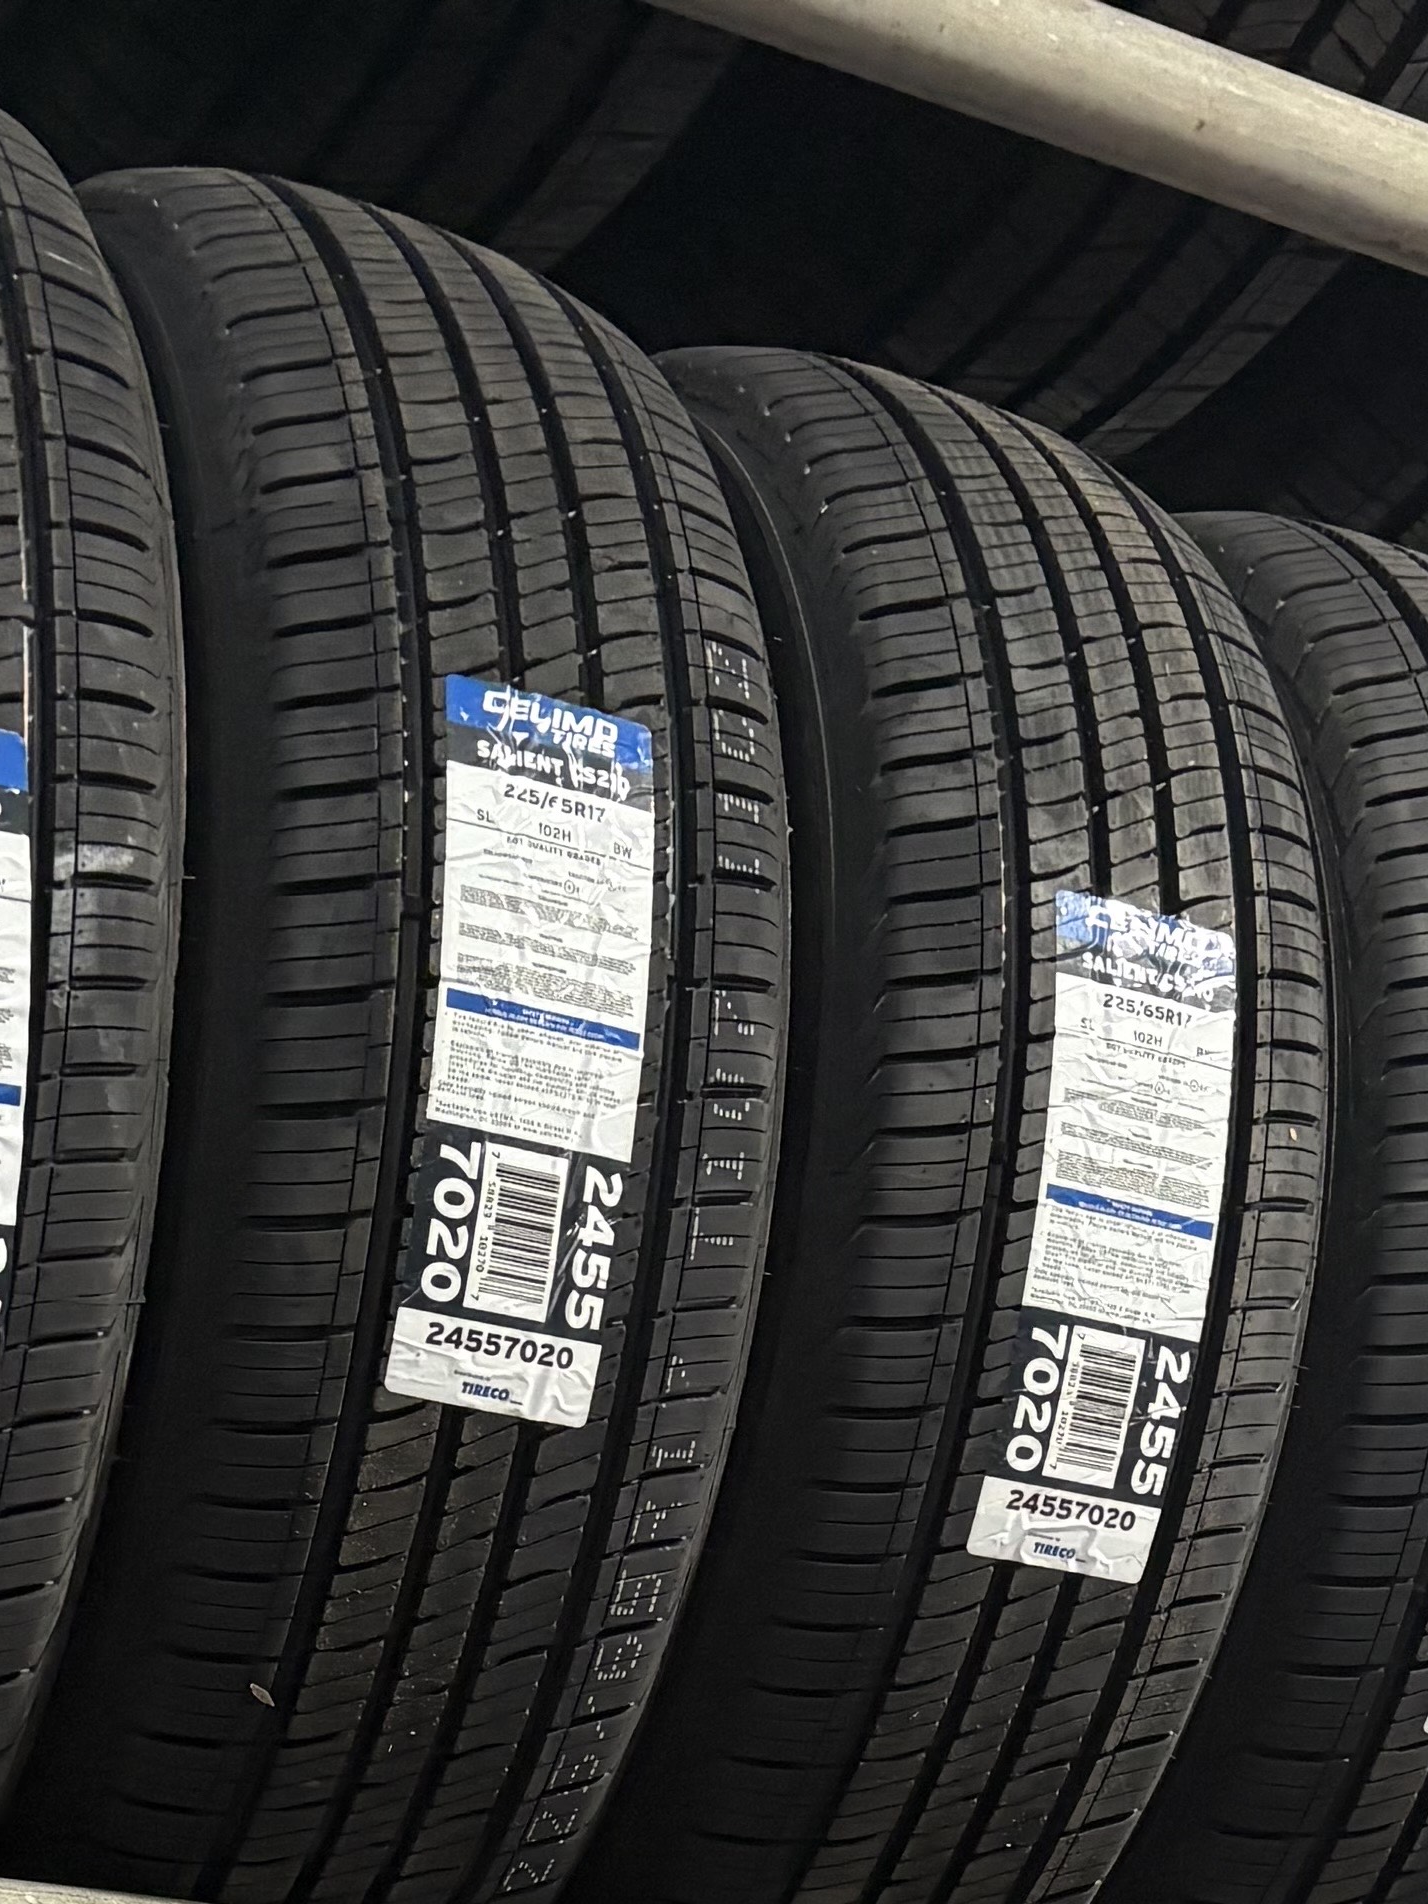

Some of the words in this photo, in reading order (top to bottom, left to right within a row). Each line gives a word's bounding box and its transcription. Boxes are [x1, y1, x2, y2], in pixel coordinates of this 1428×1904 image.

[539, 823, 571, 842] 102H
[421, 1141, 482, 1302] 7020
[565, 1165, 623, 1330] 2455
[426, 1322, 574, 1370] 24557020
[461, 1382, 510, 1401] TIRECO
[1006, 1325, 1068, 1472] 7020
[1130, 1346, 1191, 1496] 2455
[1006, 1490, 1136, 1531] 24557020
